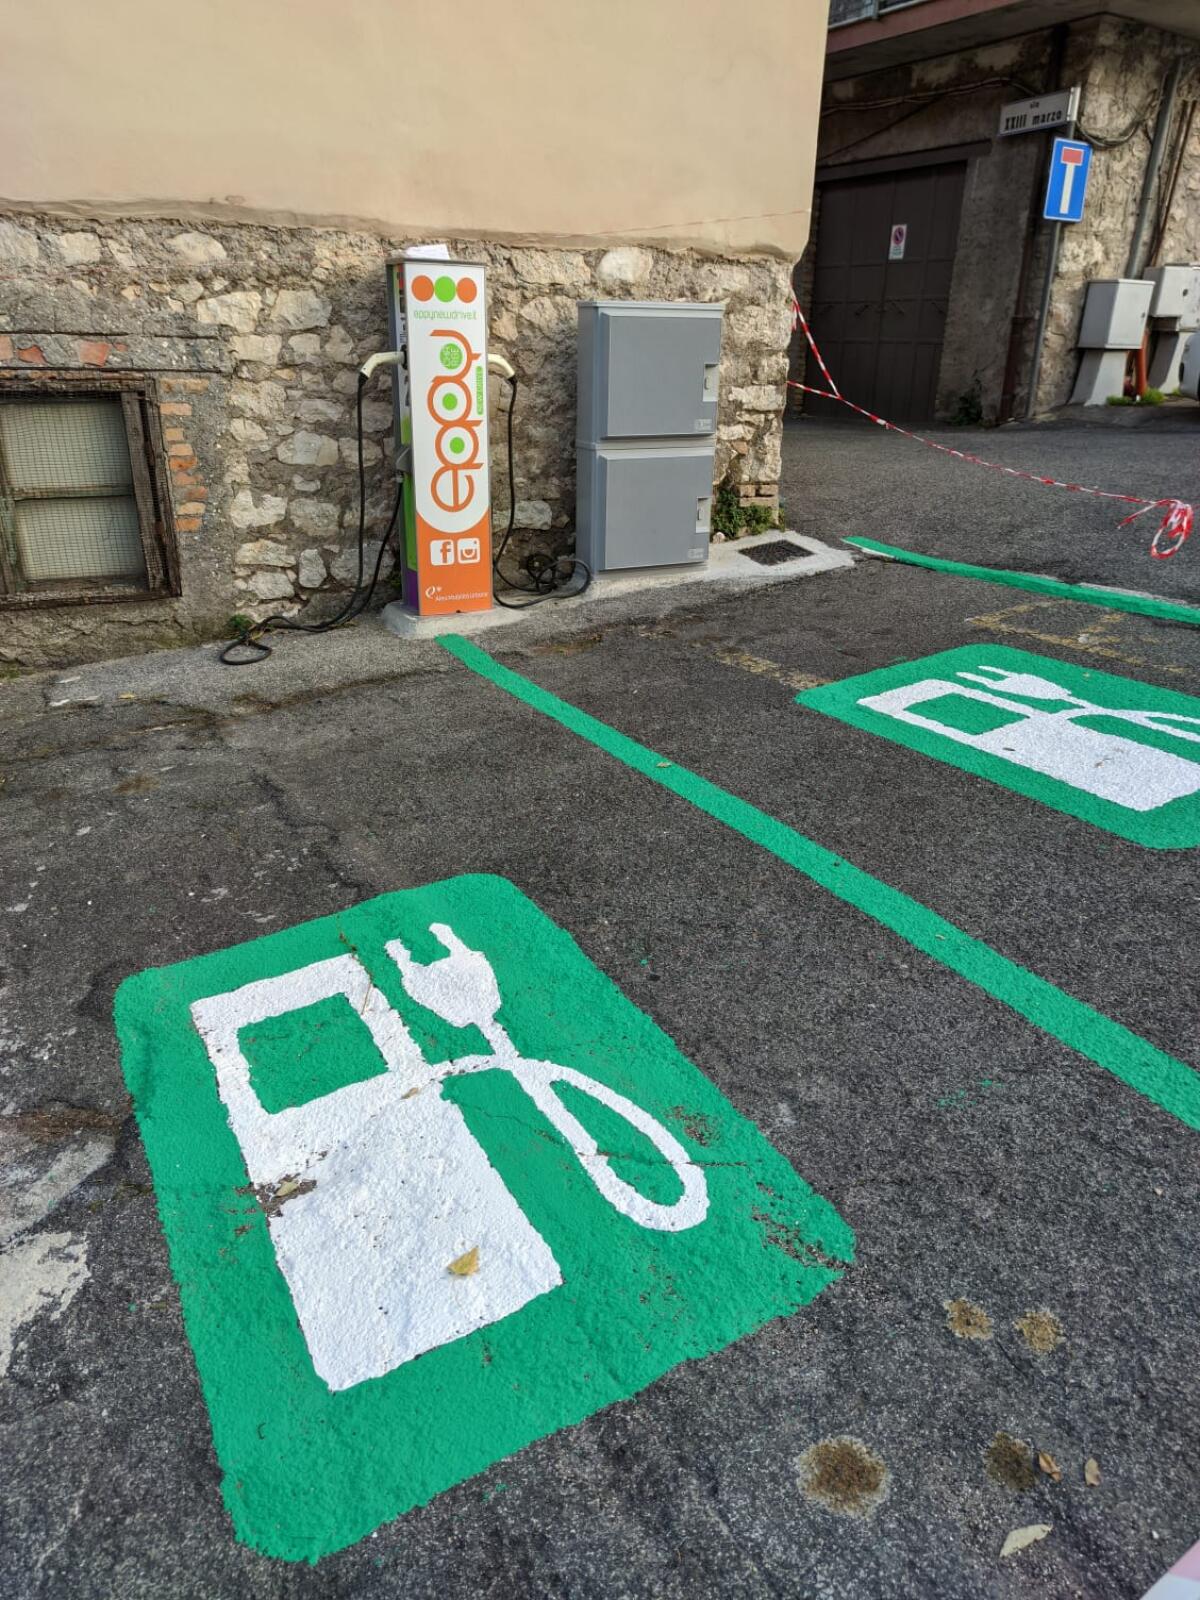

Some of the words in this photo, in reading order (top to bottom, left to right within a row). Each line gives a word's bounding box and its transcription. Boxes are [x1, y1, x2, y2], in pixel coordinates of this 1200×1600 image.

[1004, 114, 1027, 130] XXIII
[1032, 110, 1062, 125] marzo
[427, 329, 483, 513] eppy
